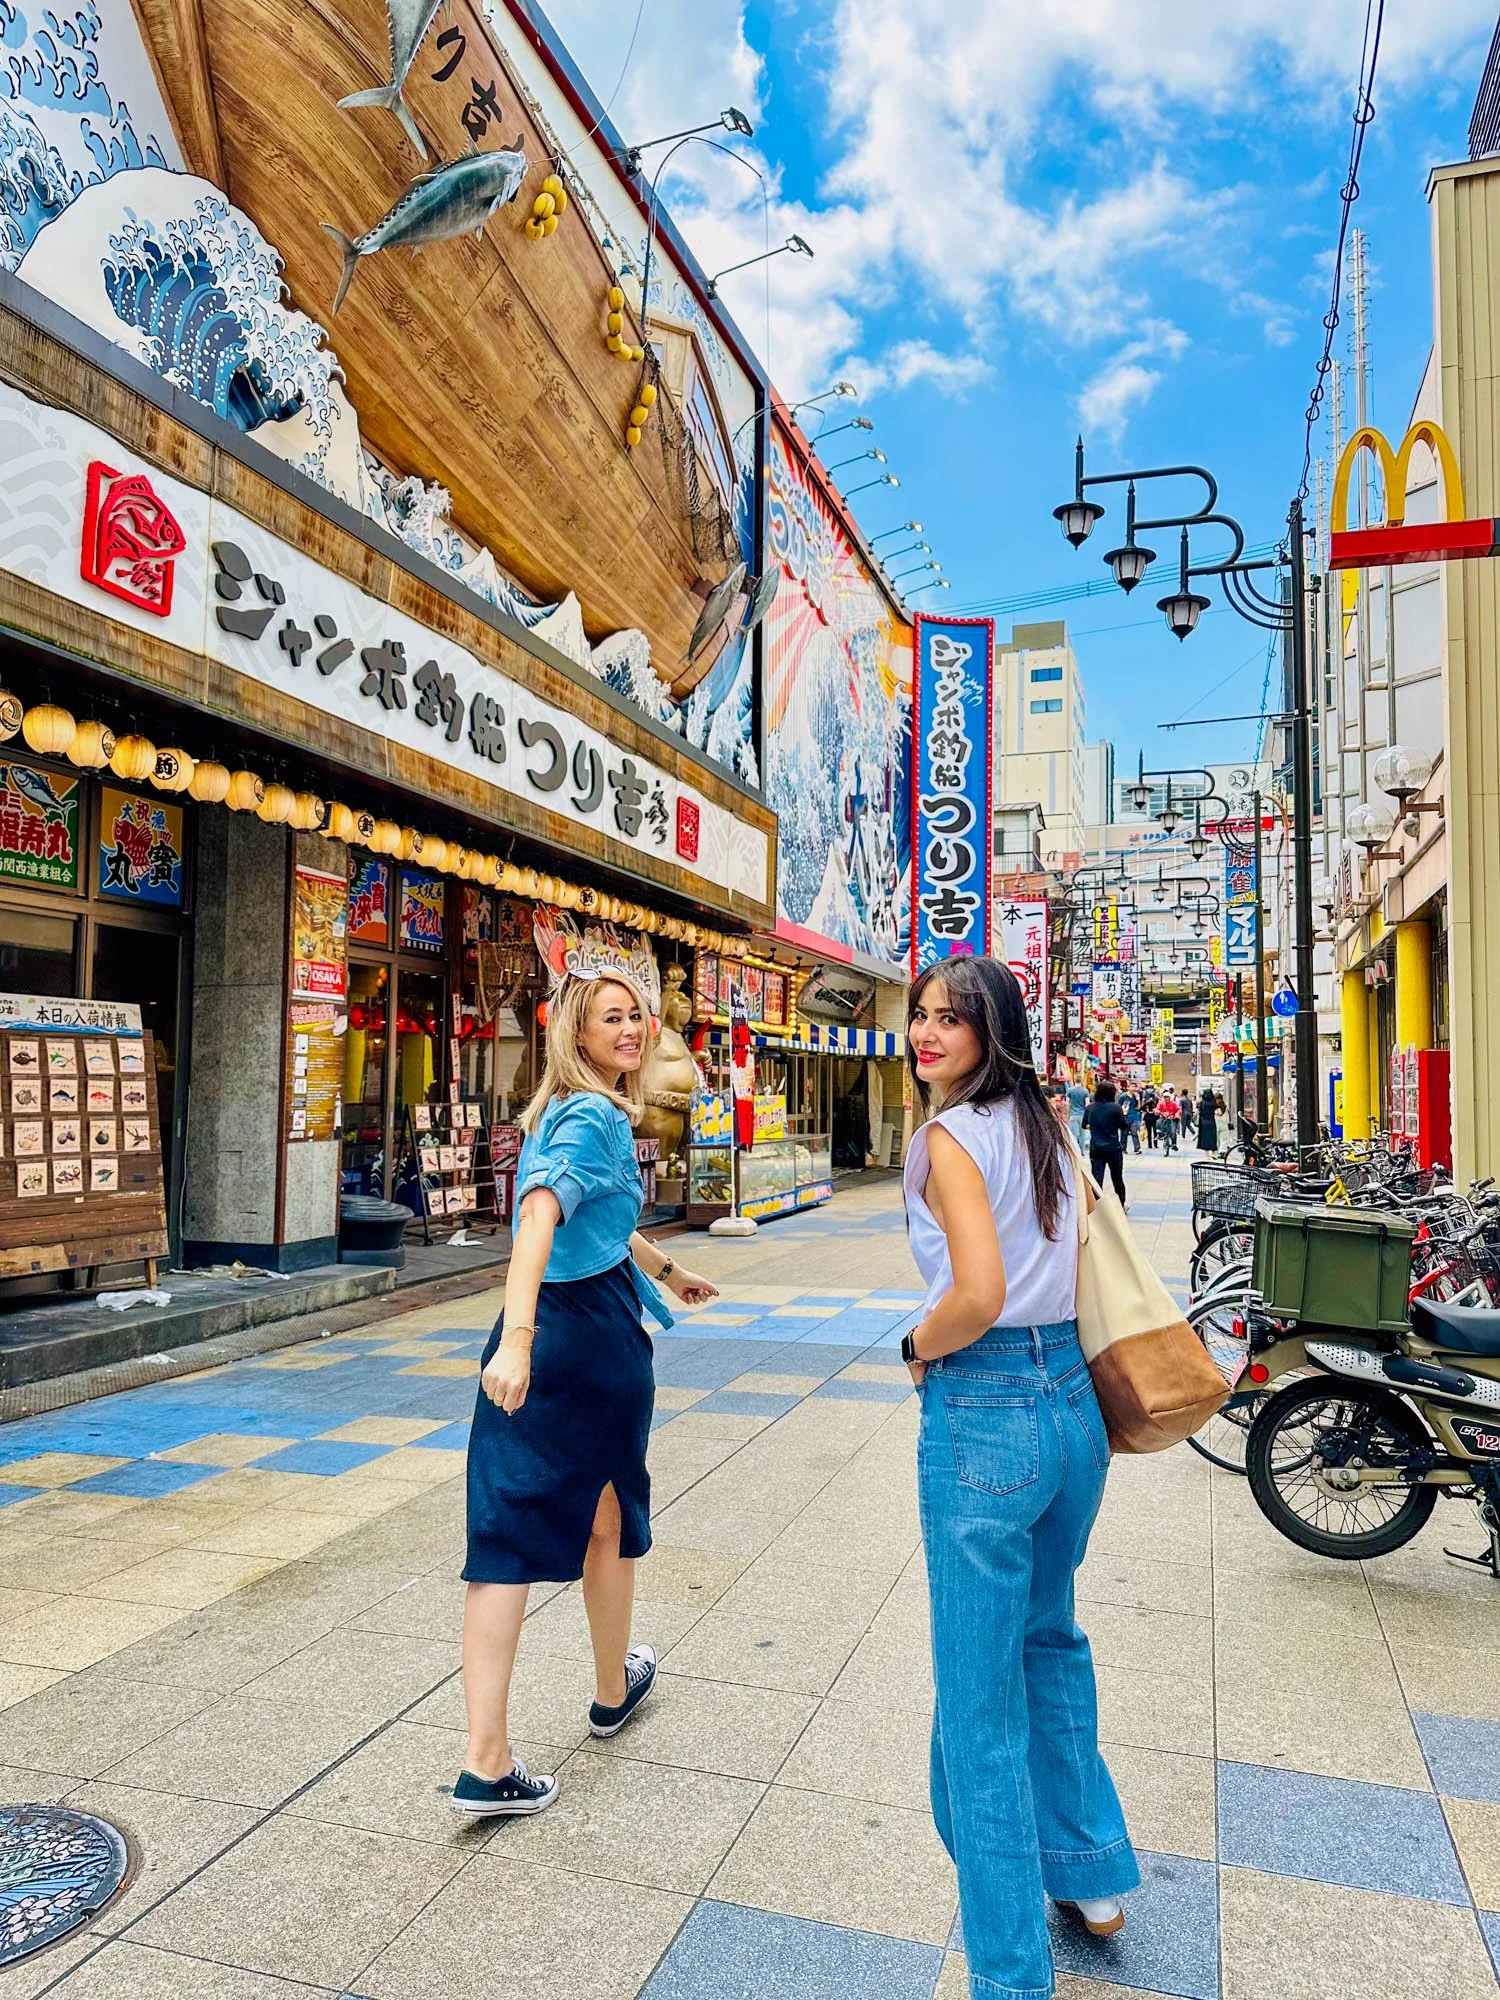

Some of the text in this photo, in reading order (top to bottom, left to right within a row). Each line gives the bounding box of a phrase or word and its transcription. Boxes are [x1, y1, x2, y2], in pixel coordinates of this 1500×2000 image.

[1227, 906, 1256, 965] マルコ
[312, 969, 342, 986] OSAKA
[36, 1005, 128, 1028] 本日の入荷情報
[1476, 1434, 1500, 1450] 12
